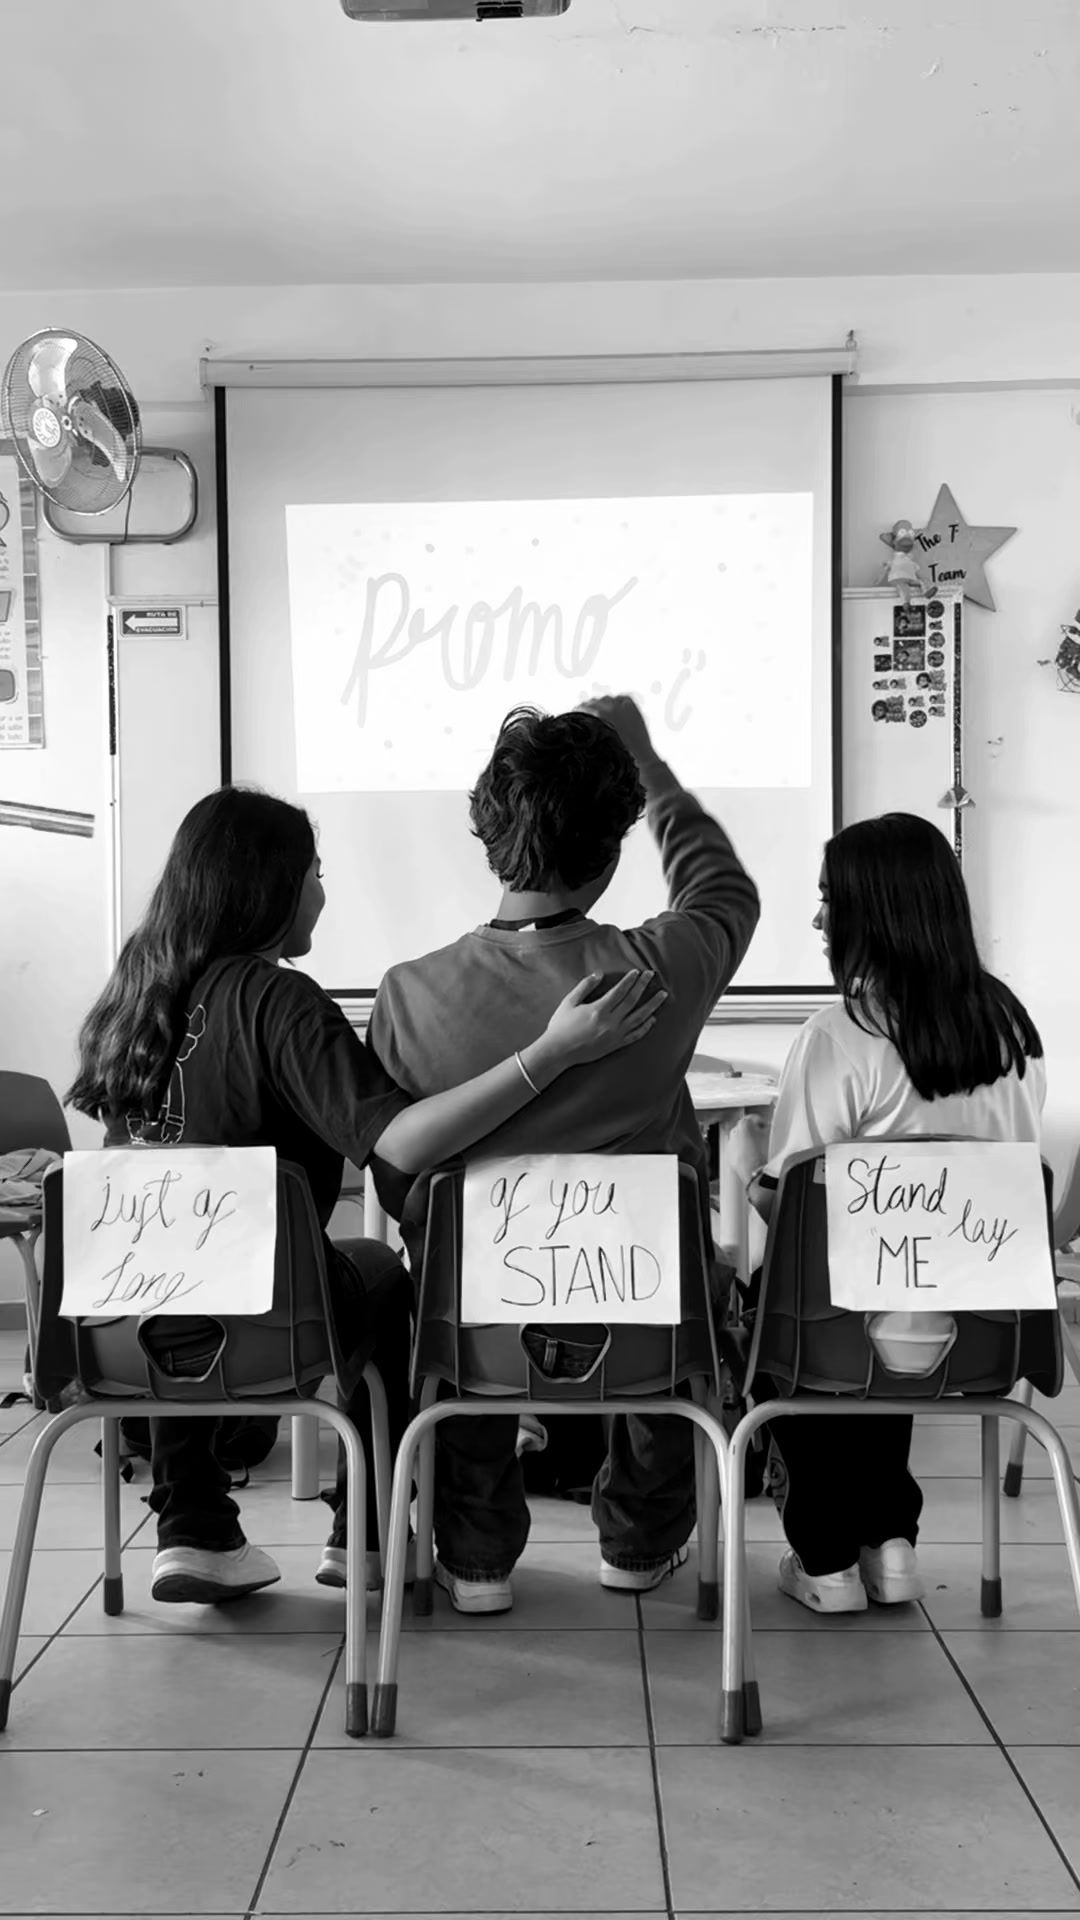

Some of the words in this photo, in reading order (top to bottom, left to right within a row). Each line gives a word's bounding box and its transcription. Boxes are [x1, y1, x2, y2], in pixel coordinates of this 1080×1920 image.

[914, 532, 942, 553] The
[927, 562, 968, 584] Team
[340, 571, 639, 729] Promo
[544, 1178, 621, 1241] you
[847, 1155, 948, 1215] Stand
[500, 1244, 662, 1307] STAND
[877, 1234, 939, 1289] ME
